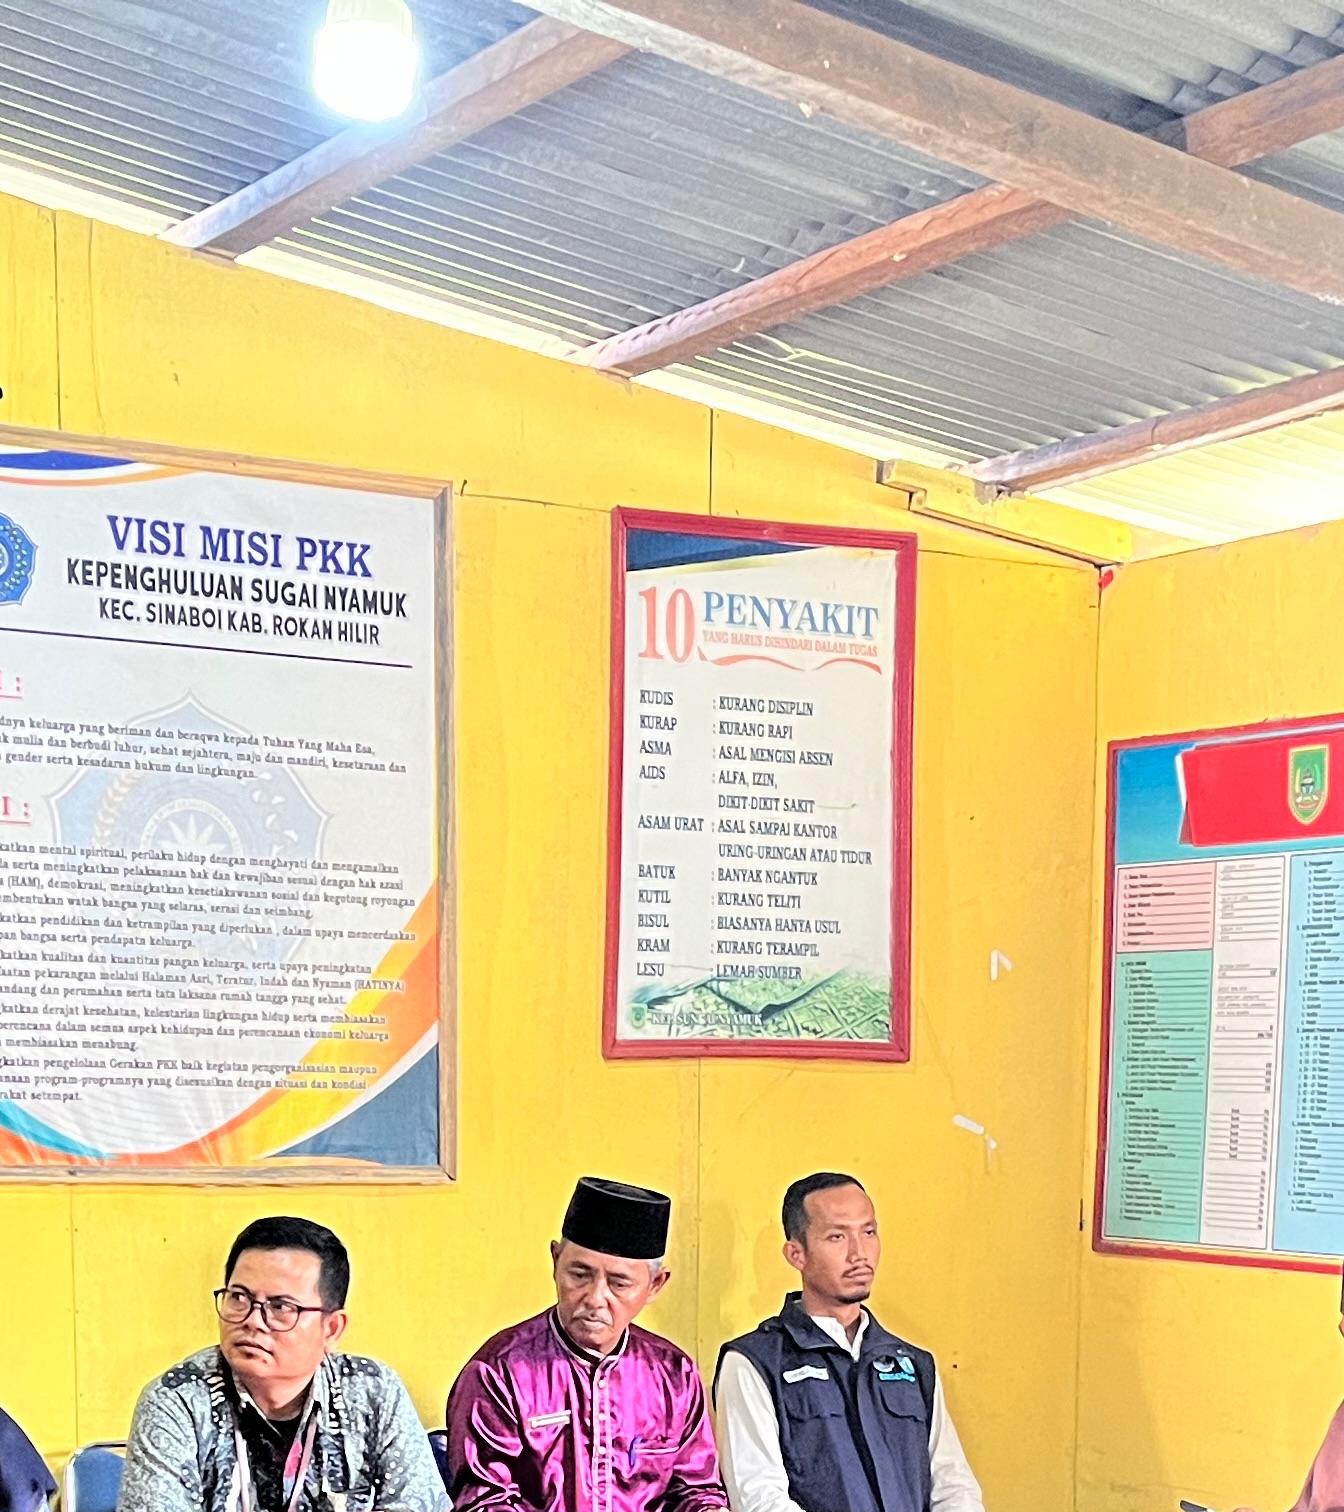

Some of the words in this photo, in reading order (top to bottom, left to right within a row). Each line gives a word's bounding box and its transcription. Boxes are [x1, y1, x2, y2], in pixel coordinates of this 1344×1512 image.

[107, 515, 185, 557] VISI
[200, 526, 282, 566] MISI
[297, 537, 372, 577] PKK
[67, 558, 243, 601] KEPENGHULUAN
[252, 580, 318, 609] SUGAI
[324, 586, 407, 618] NYAMUK
[99, 598, 141, 622] KEC.
[147, 603, 223, 630] SINABOI
[227, 610, 268, 634] KAB.
[273, 617, 332, 640] ROKAN
[338, 622, 380, 645] HILIR
[638, 586, 695, 663] 10
[704, 591, 878, 637] PENYAKIT
[640, 690, 674, 705] KUDIS
[719, 696, 765, 712] KURANG
[640, 715, 677, 730] KURAP
[719, 721, 764, 737] KURANG
[768, 724, 793, 739] RAPI
[223, 732, 258, 747] kepada
[262, 735, 294, 747] Tuhan
[298, 738, 322, 752] Yang
[640, 740, 671, 756] ASMA
[719, 746, 747, 761] ASAL
[639, 765, 666, 779] AIDS
[783, 798, 815, 813] SAKIT
[638, 815, 671, 830] ASAM
[675, 818, 704, 831] URAT
[718, 820, 745, 834] ASAL
[750, 822, 790, 836] SAMPAI
[794, 825, 837, 839] KANTOR
[810, 848, 837, 863] ATAU
[840, 851, 872, 864] TIDUR
[638, 864, 675, 879] BATUK
[718, 868, 762, 883] BANYAK
[765, 870, 818, 885] NGANTUK
[638, 890, 671, 903] KUTIL
[718, 892, 763, 907] KURANG
[638, 914, 669, 928] BISUL
[717, 917, 772, 932] BIASANYA
[775, 919, 811, 933] HANYA
[814, 920, 840, 934] USUL
[637, 939, 670, 952] KRAM
[717, 941, 762, 955] KURANG
[766, 942, 819, 957] TERAMPIL
[637, 963, 665, 976] LESU
[758, 966, 802, 979] SUMBER
